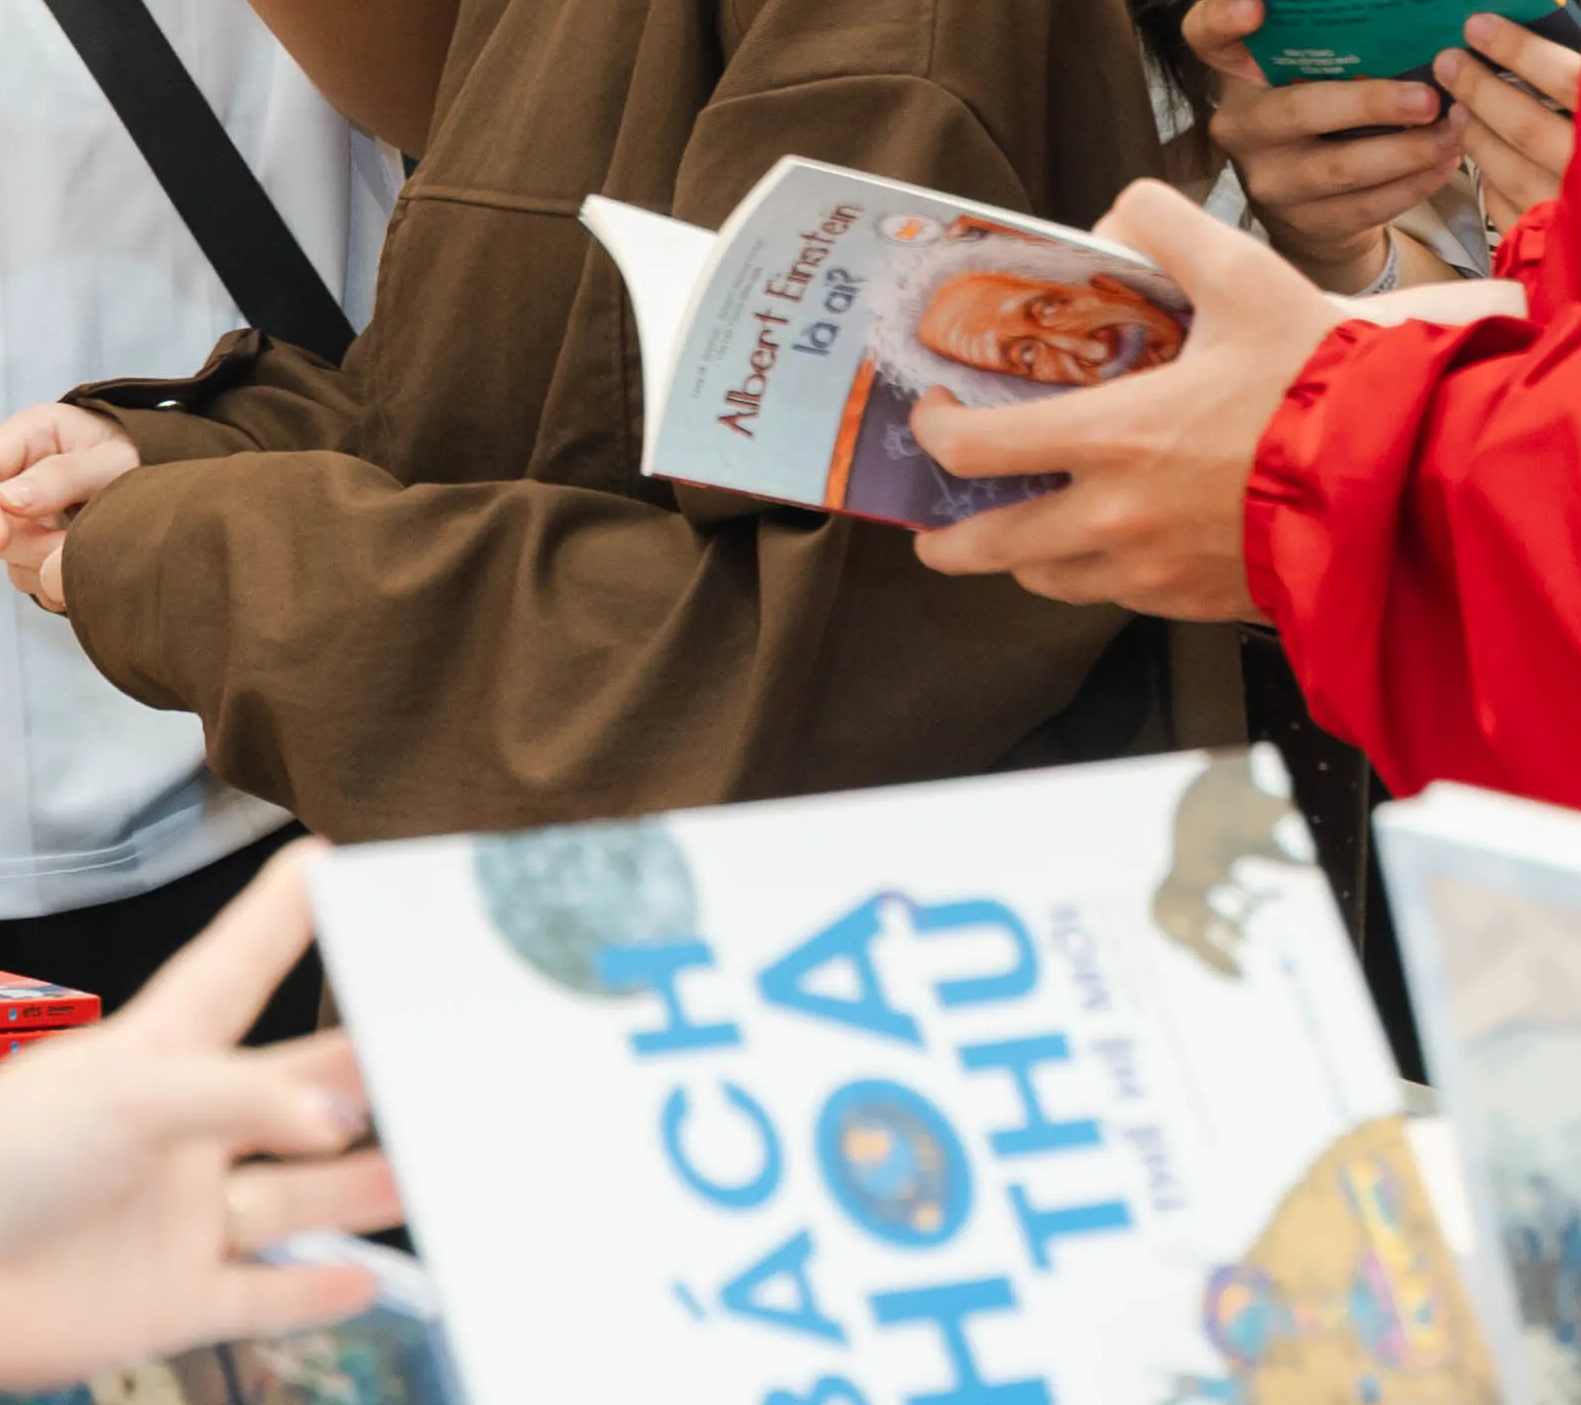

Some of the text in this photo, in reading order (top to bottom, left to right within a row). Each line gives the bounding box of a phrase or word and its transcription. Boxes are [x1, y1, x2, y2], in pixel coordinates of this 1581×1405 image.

[717, 308, 790, 439] Albert
[764, 203, 865, 303] Einstein
[824, 267, 868, 314] ai?
